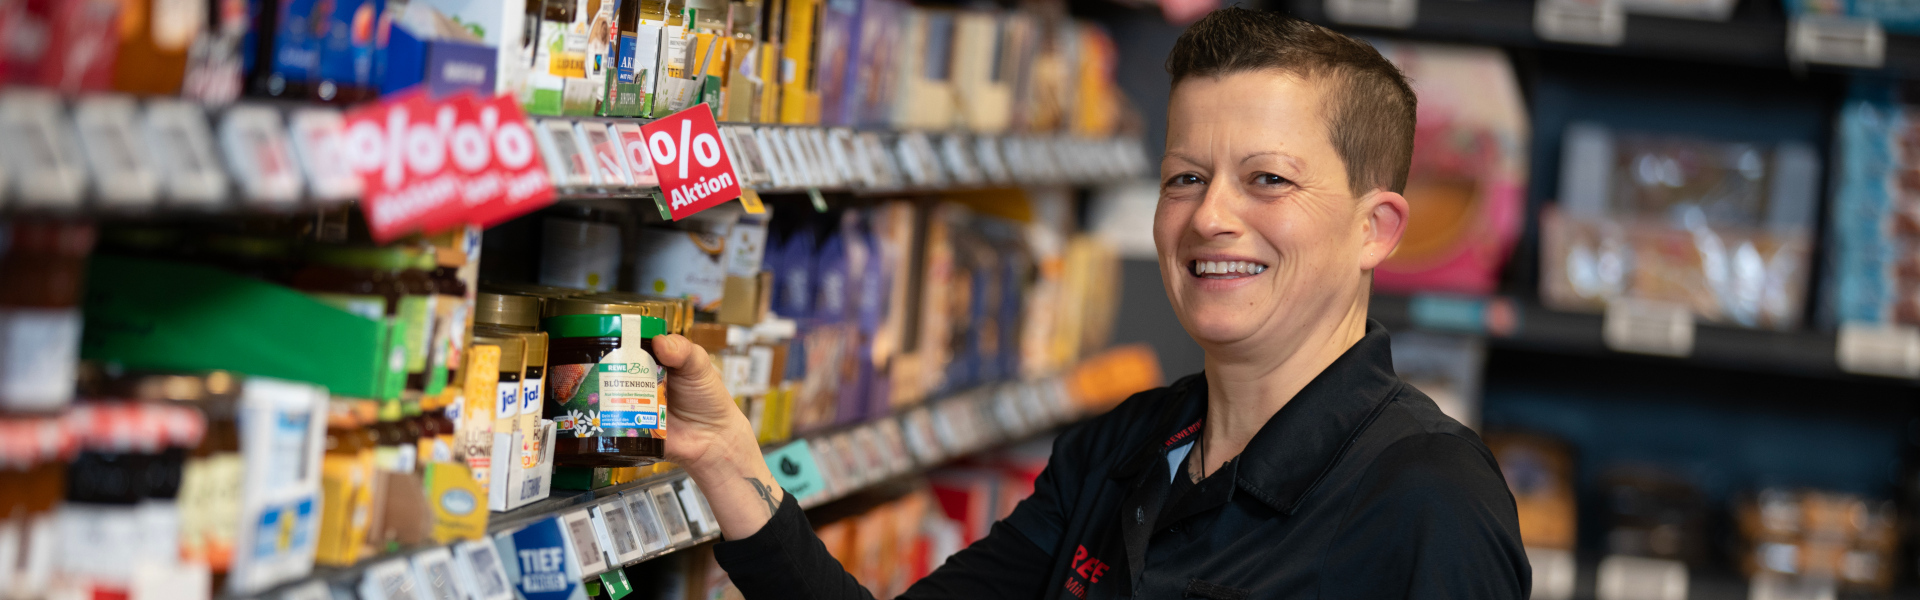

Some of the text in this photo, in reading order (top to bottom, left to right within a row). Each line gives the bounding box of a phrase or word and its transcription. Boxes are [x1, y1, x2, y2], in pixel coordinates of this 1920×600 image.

[648, 119, 721, 179] %
[671, 172, 734, 211] Aktion
[628, 363, 649, 374] Bio
[604, 380, 655, 388] BLÜTENHONIG
[502, 388, 517, 413] ja!
[523, 385, 539, 409] ja!
[518, 546, 564, 574] TIEF
